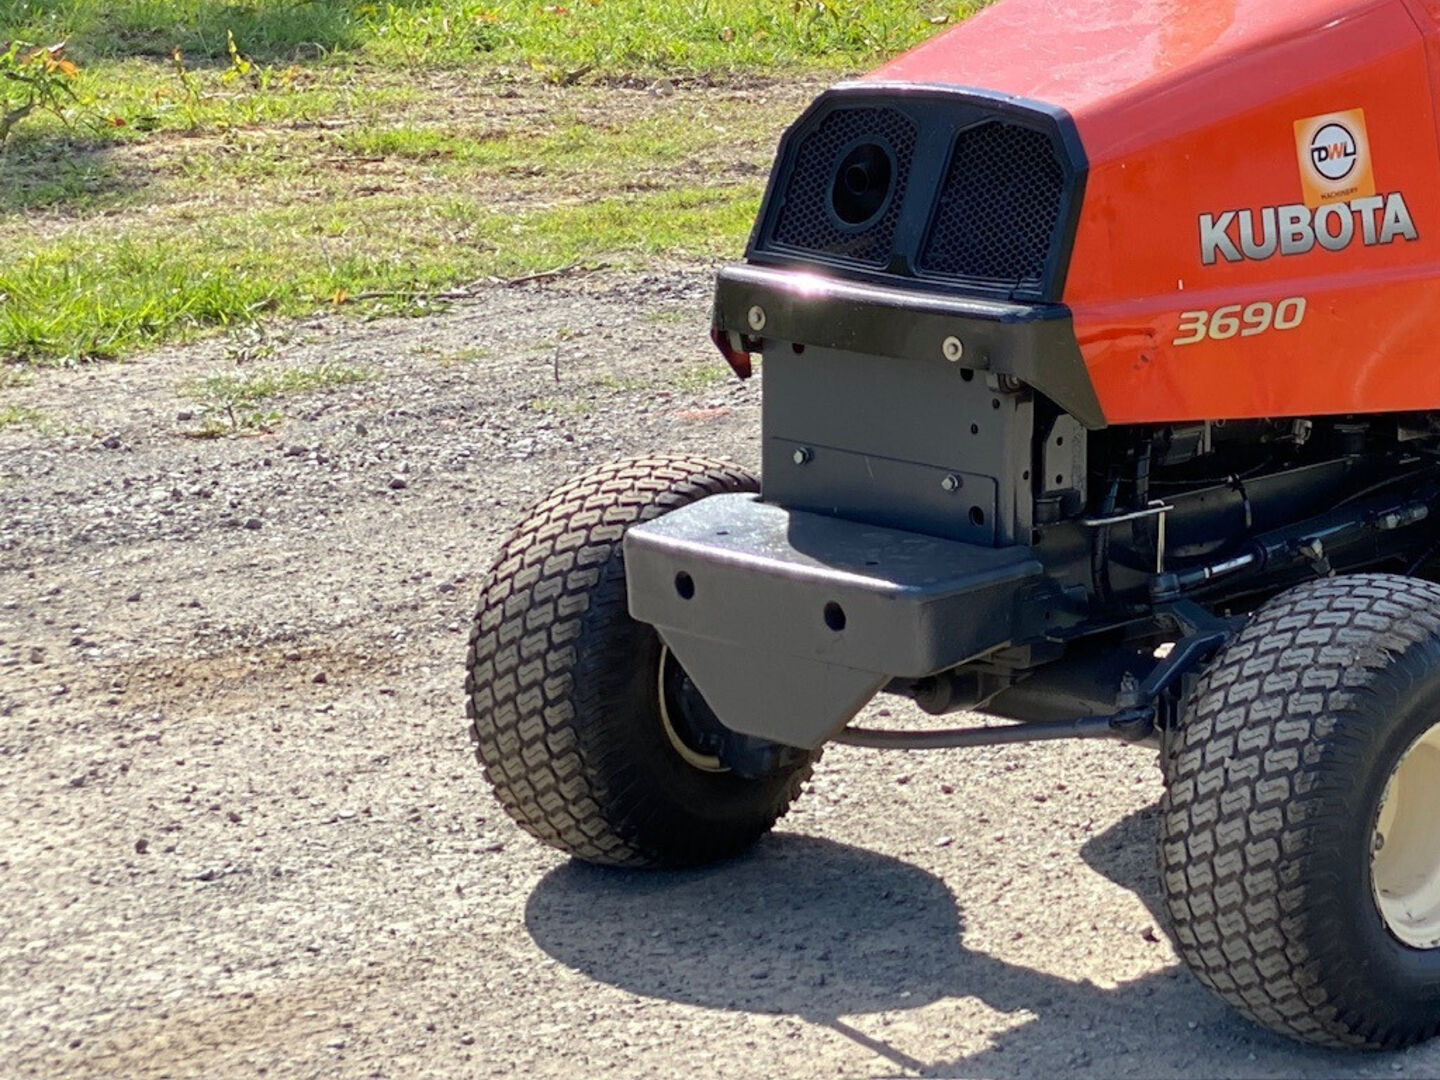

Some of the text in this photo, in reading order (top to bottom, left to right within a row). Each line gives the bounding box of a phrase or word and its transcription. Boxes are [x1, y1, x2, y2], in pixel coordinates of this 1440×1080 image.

[1312, 141, 1357, 162] DWL
[1320, 187, 1358, 200] MACHINERY
[1199, 191, 1418, 266] KUBOTA
[1172, 296, 1306, 345] 3690
